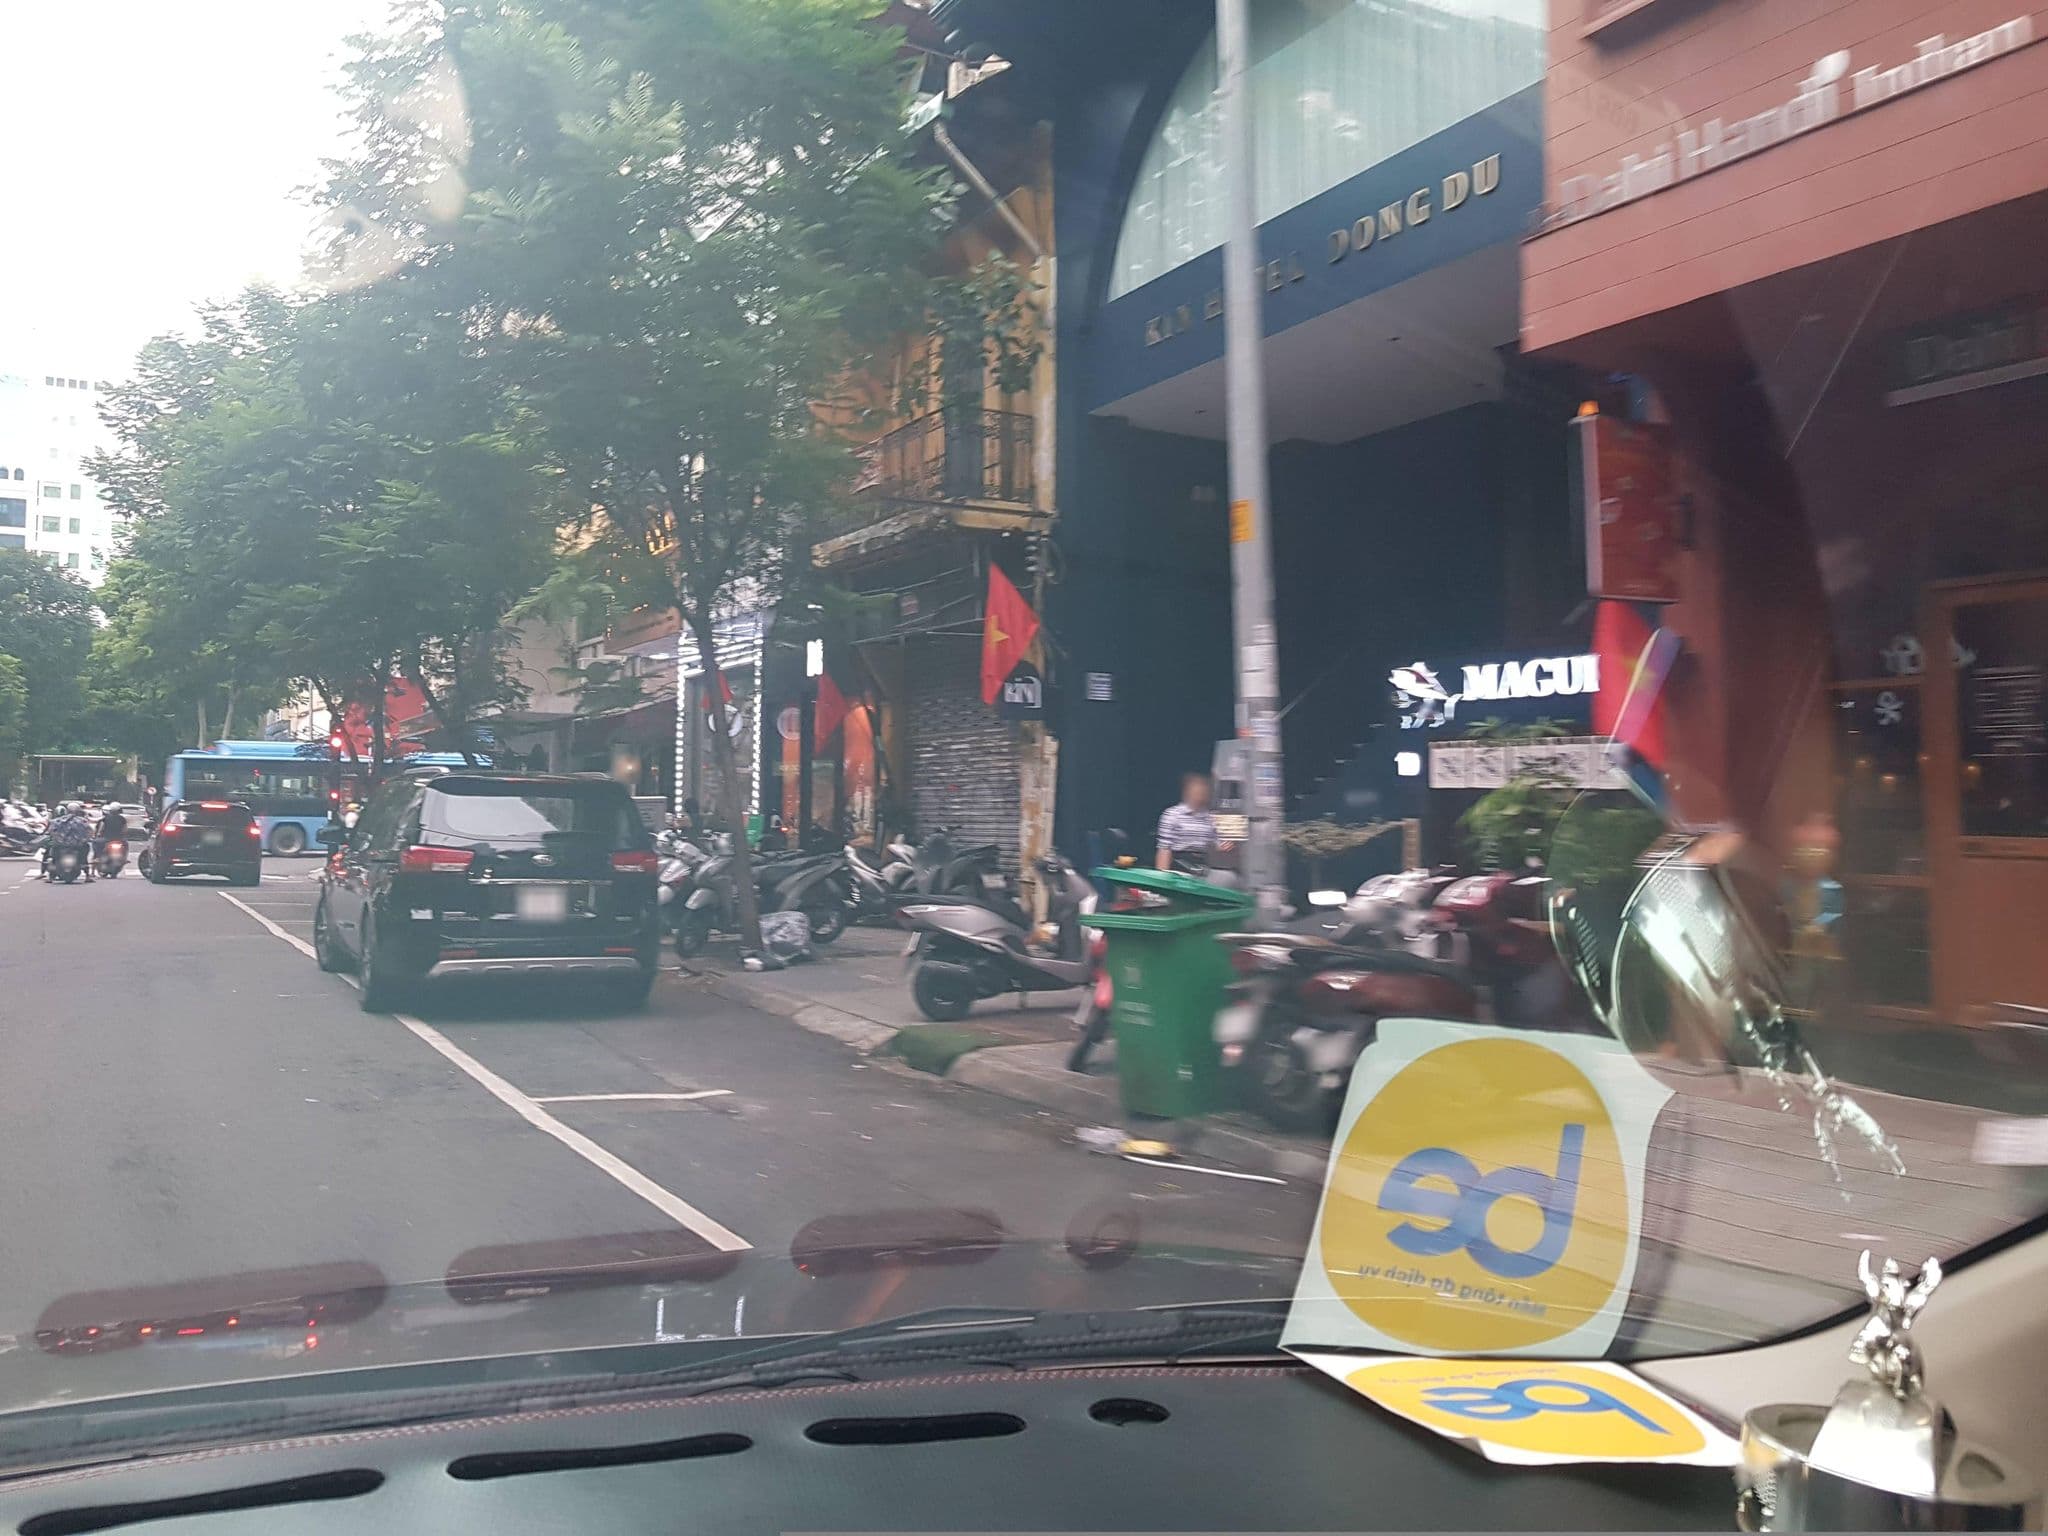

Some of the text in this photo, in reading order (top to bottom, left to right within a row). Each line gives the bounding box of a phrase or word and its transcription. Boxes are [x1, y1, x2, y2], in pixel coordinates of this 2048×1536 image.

[1677, 50, 1848, 180] Handi
[1849, 14, 2034, 110] Indian
[1327, 188, 1431, 264] DONG
[1442, 153, 1501, 212] DU
